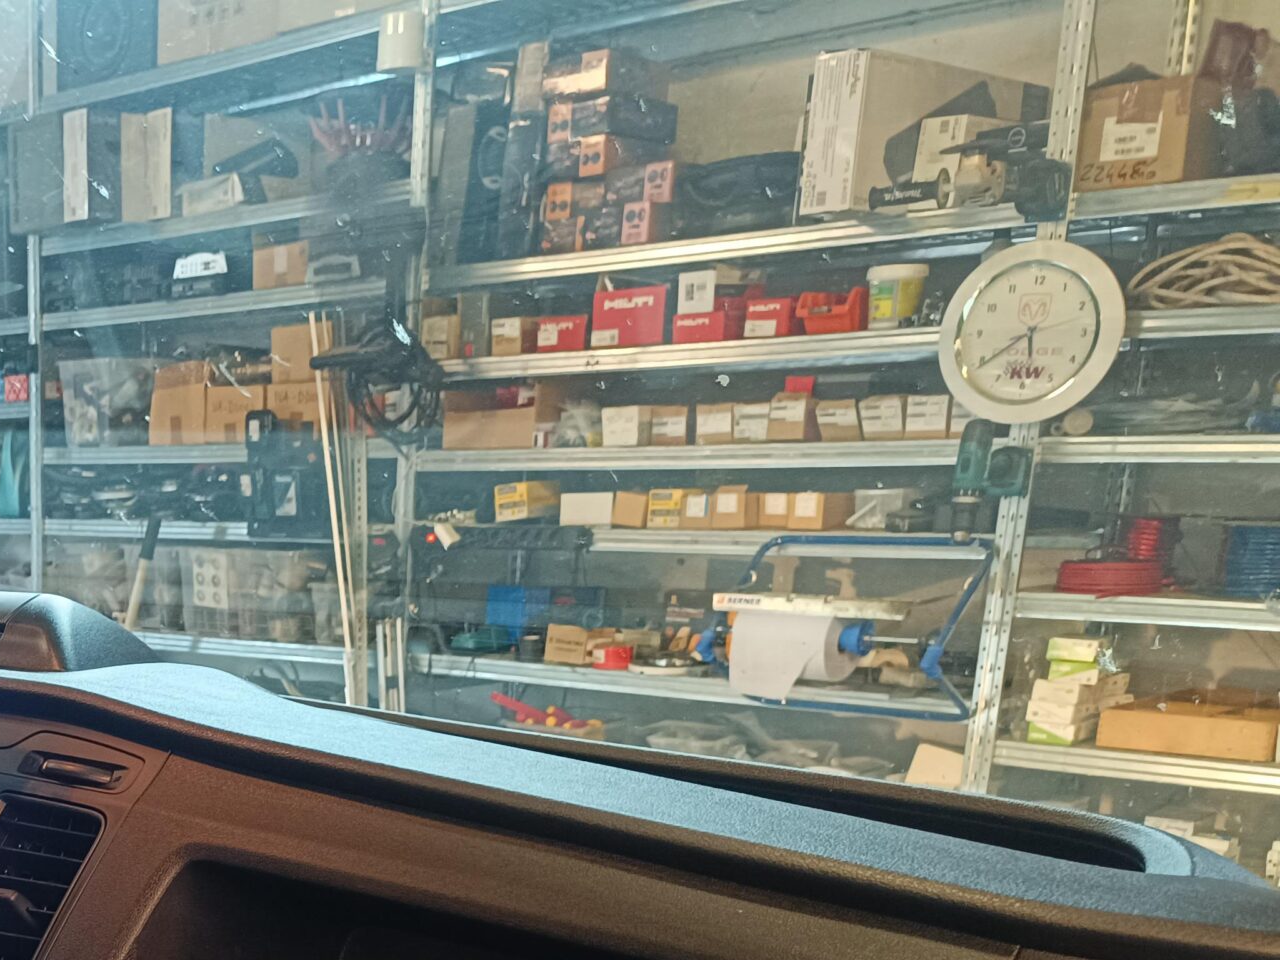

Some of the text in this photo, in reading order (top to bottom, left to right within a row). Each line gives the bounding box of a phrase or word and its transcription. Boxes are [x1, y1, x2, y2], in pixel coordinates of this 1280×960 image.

[1034, 275, 1046, 286] 12
[1008, 284, 1017, 294] 11
[604, 295, 654, 311] HILTI
[986, 303, 997, 313] 10
[1078, 301, 1086, 311] 2
[976, 329, 984, 339] 9
[1080, 328, 1088, 338] 3
[1069, 354, 1076, 364] 4
[1009, 365, 1045, 380] KW
[1047, 373, 1054, 383] 5
[1019, 381, 1026, 390] 6
